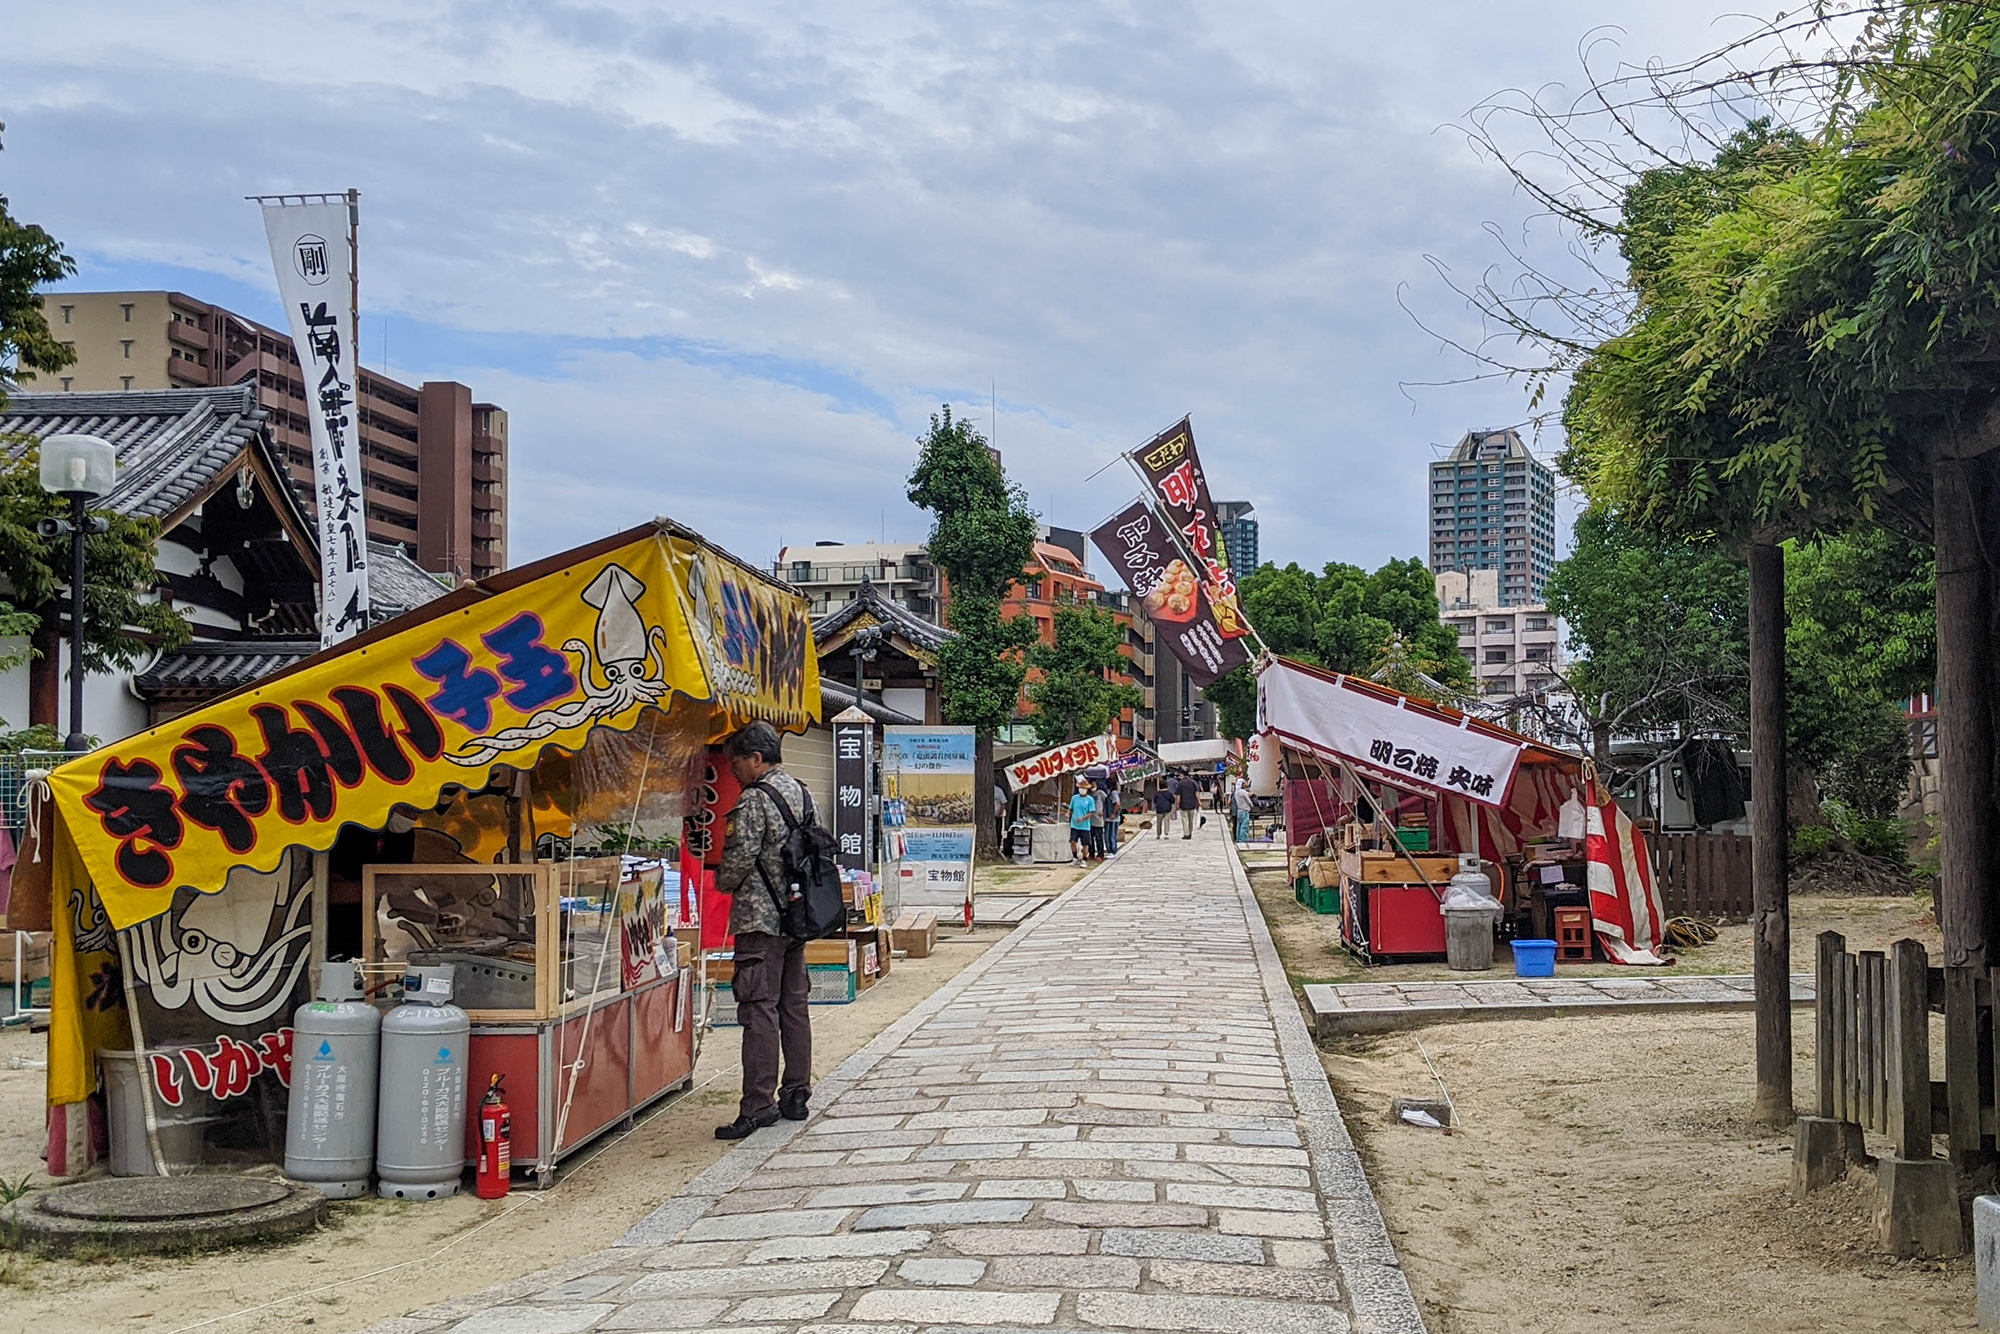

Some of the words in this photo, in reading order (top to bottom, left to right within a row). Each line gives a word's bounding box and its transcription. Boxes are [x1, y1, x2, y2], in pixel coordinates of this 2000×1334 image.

[838, 736, 862, 856] 宝物館
[1369, 738, 1440, 780] 明石焼
[1446, 765, 1495, 797] 央味
[927, 869, 966, 882] 宝物館
